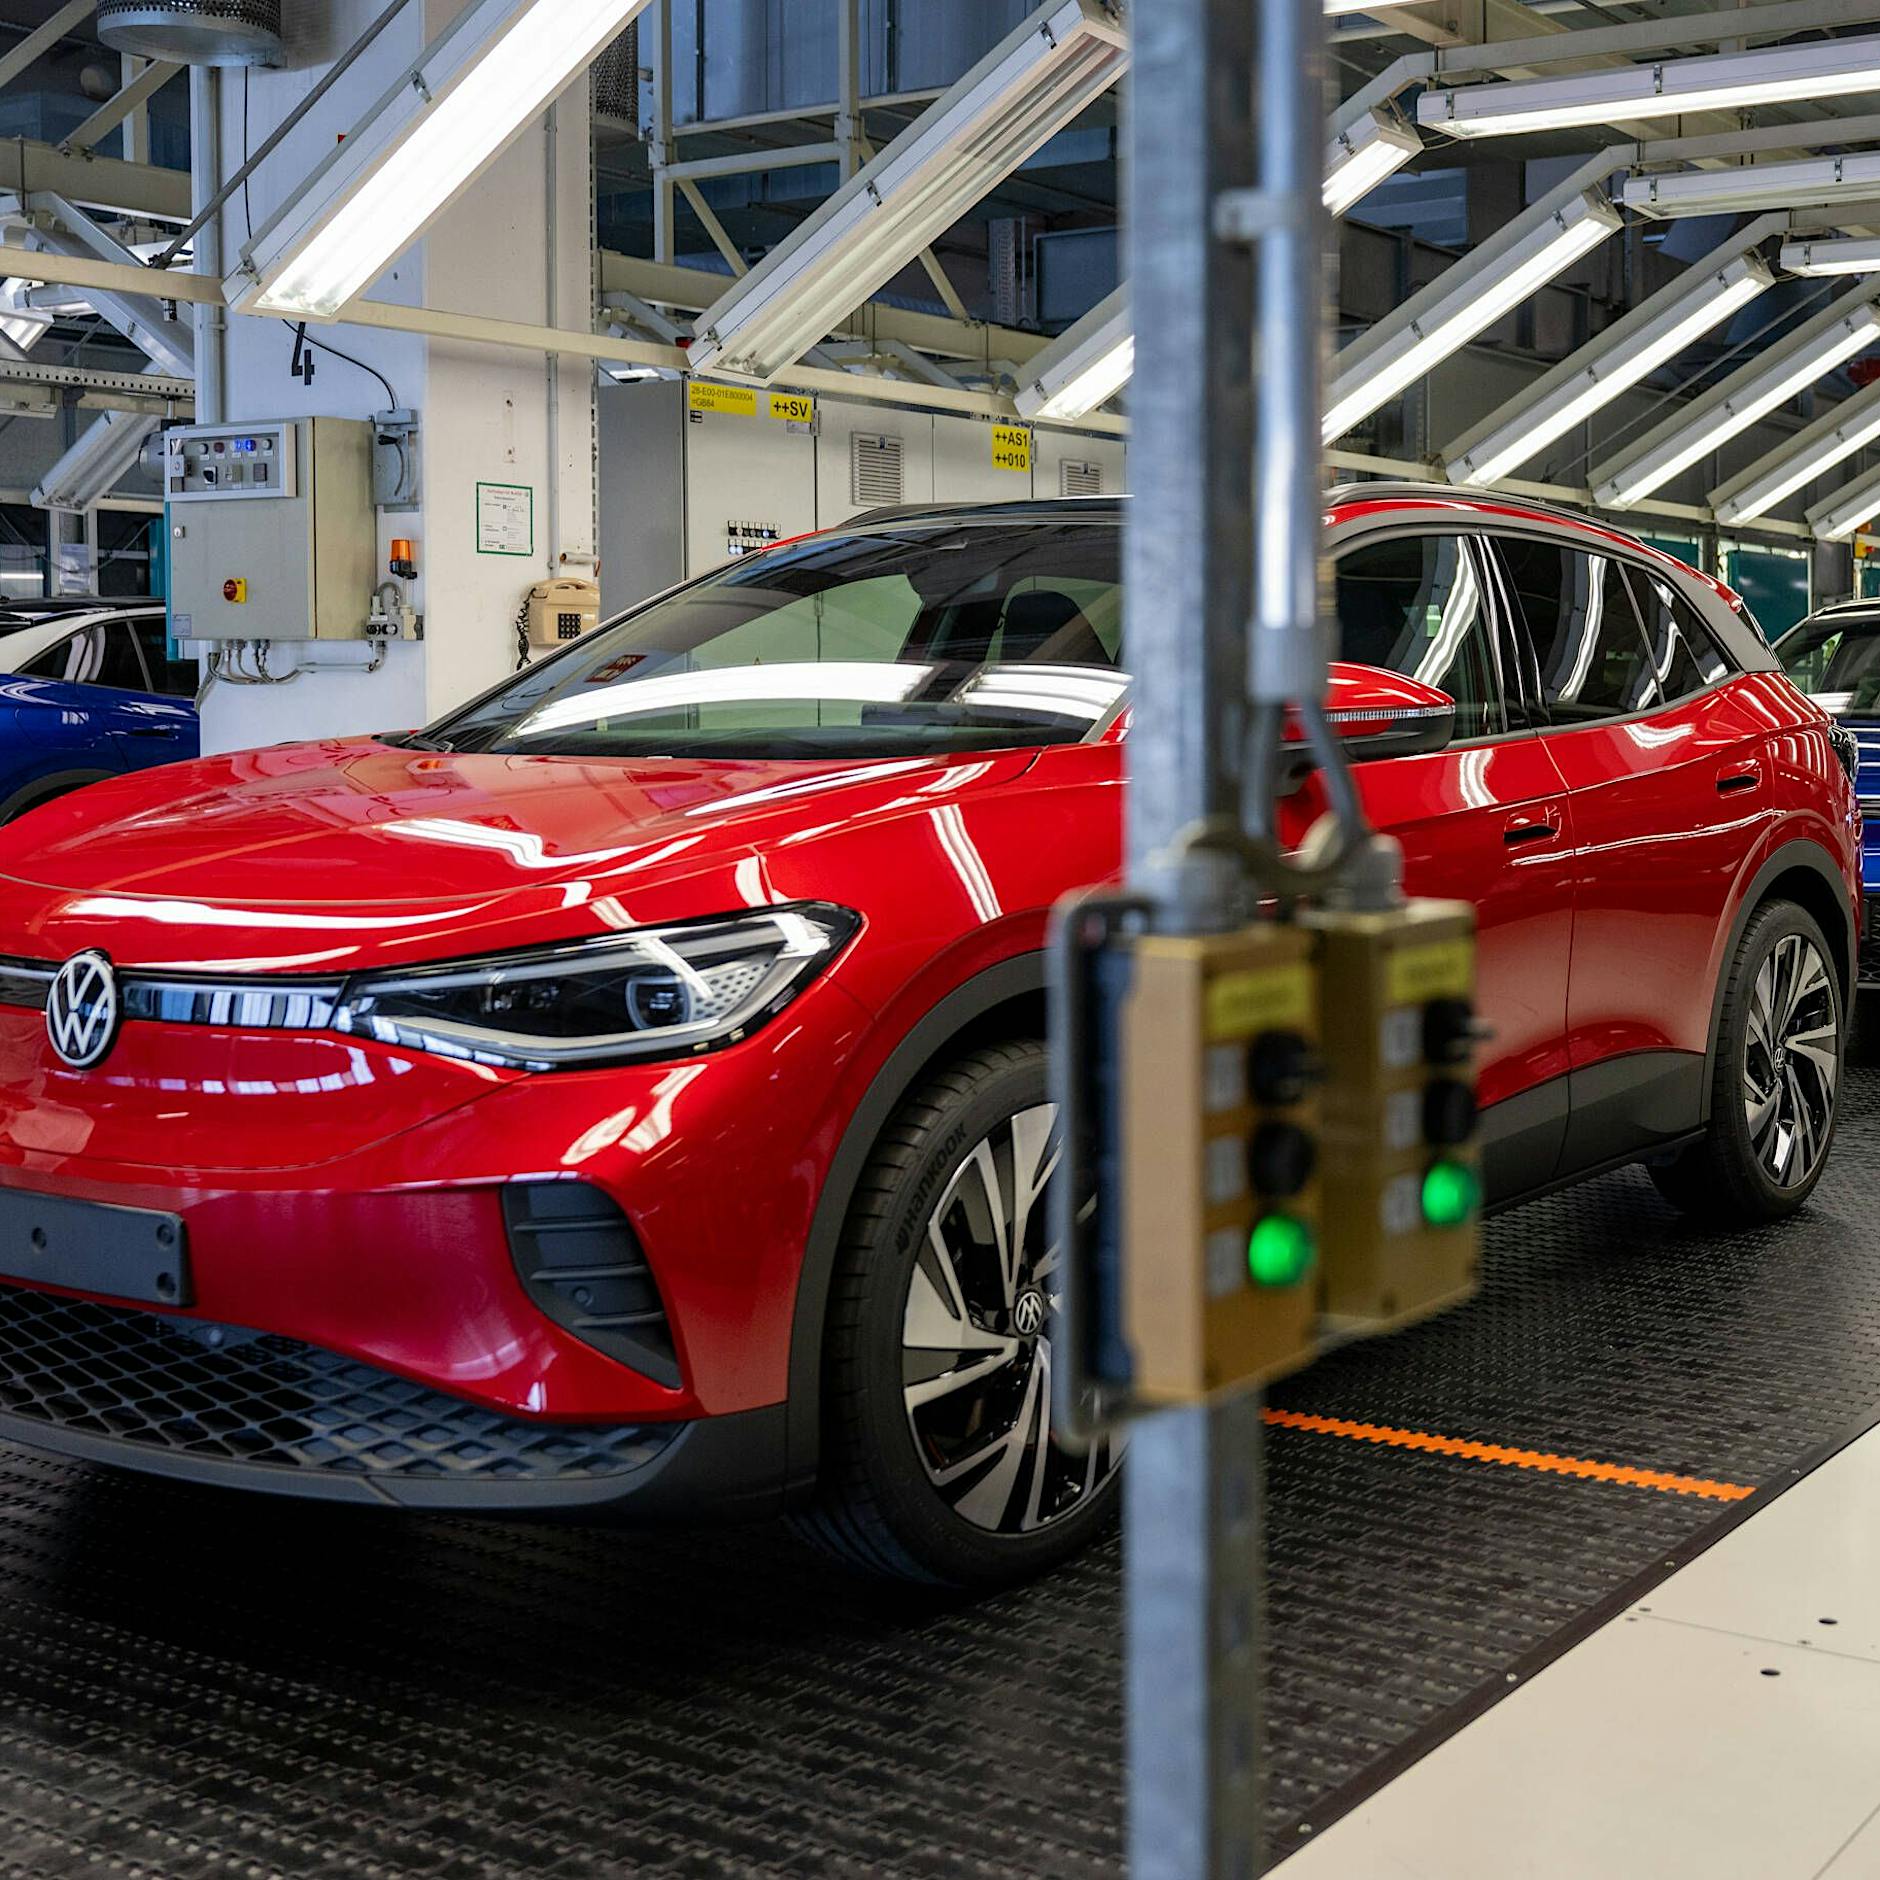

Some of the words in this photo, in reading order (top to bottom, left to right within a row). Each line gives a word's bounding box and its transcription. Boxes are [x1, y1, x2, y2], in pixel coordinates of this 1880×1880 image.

[773, 401, 808, 418] ++SV
[995, 432, 1028, 448] ++AS1
[995, 453, 1026, 468] ++010
